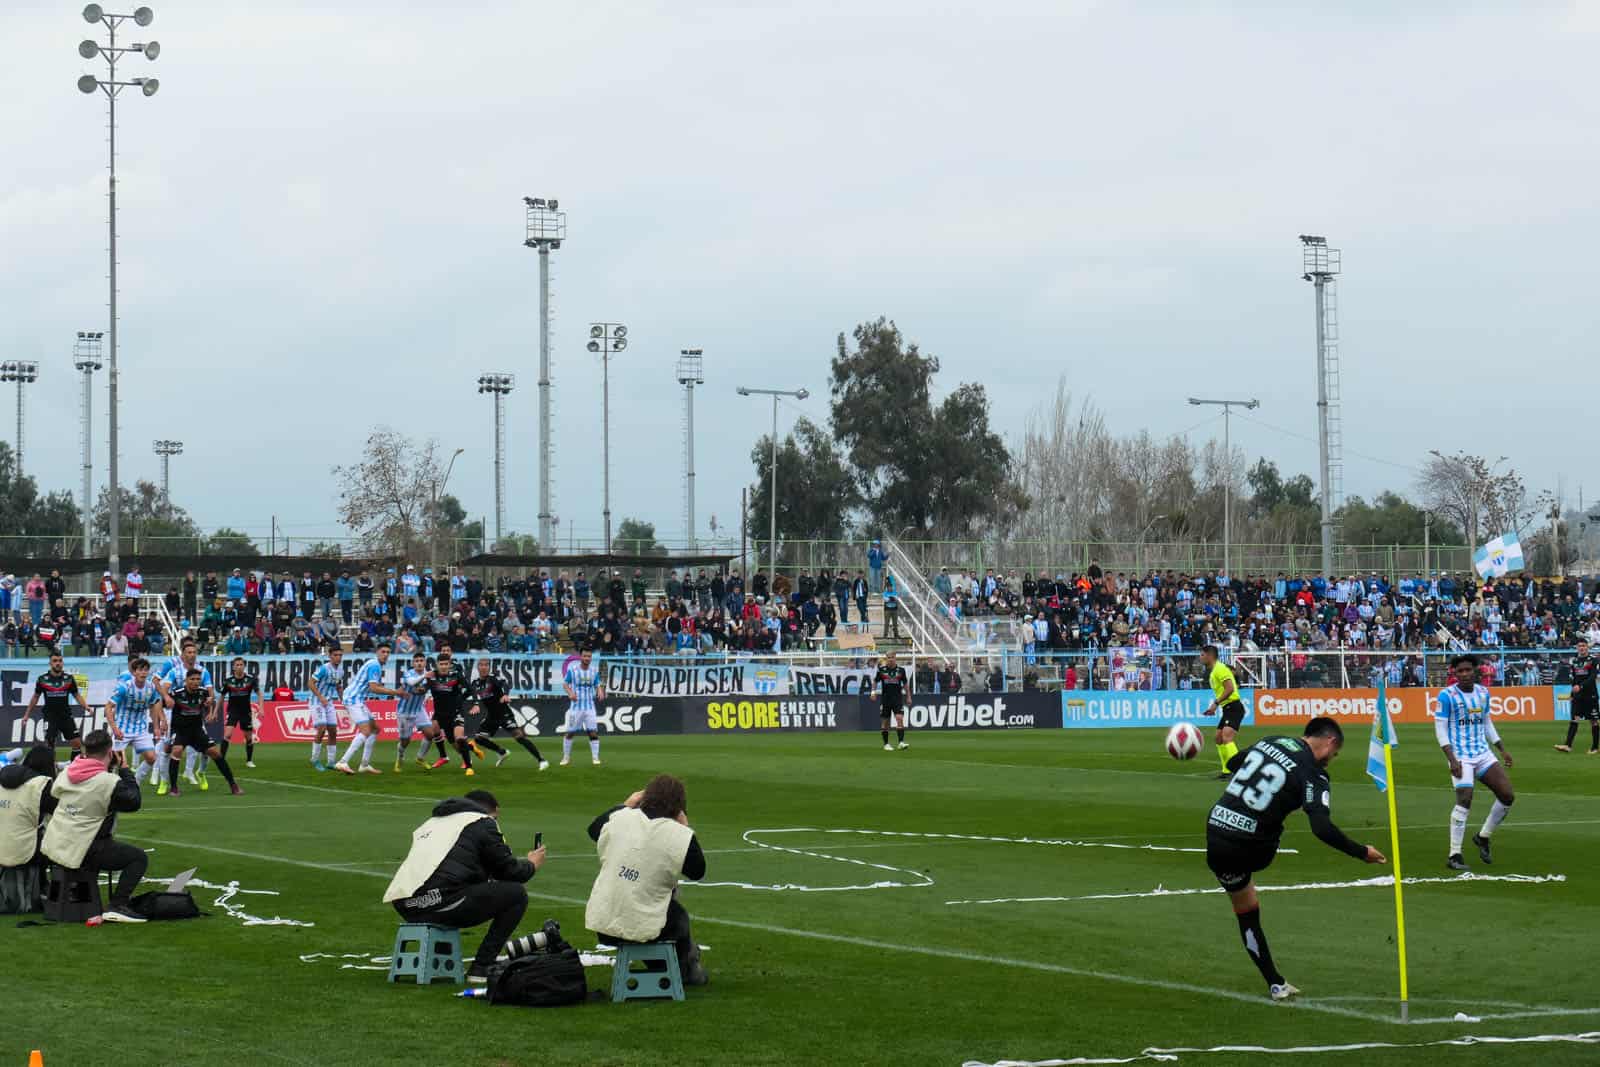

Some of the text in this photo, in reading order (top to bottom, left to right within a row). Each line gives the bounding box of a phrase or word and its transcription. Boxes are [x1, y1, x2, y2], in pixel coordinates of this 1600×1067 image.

[491, 659, 553, 691] ESISTE
[608, 664, 745, 696] CHUPAPILSEN
[707, 701, 780, 729] SCORE
[780, 701, 836, 714] ENERGY
[1087, 697, 1251, 720] CLUB MAGALLS
[1257, 694, 1403, 718] Campeonao
[1425, 691, 1537, 716] bson
[780, 713, 837, 727] DRINK
[1225, 749, 1287, 812] 23
[1214, 808, 1254, 831] KAYSER
[618, 865, 640, 881] 2469
